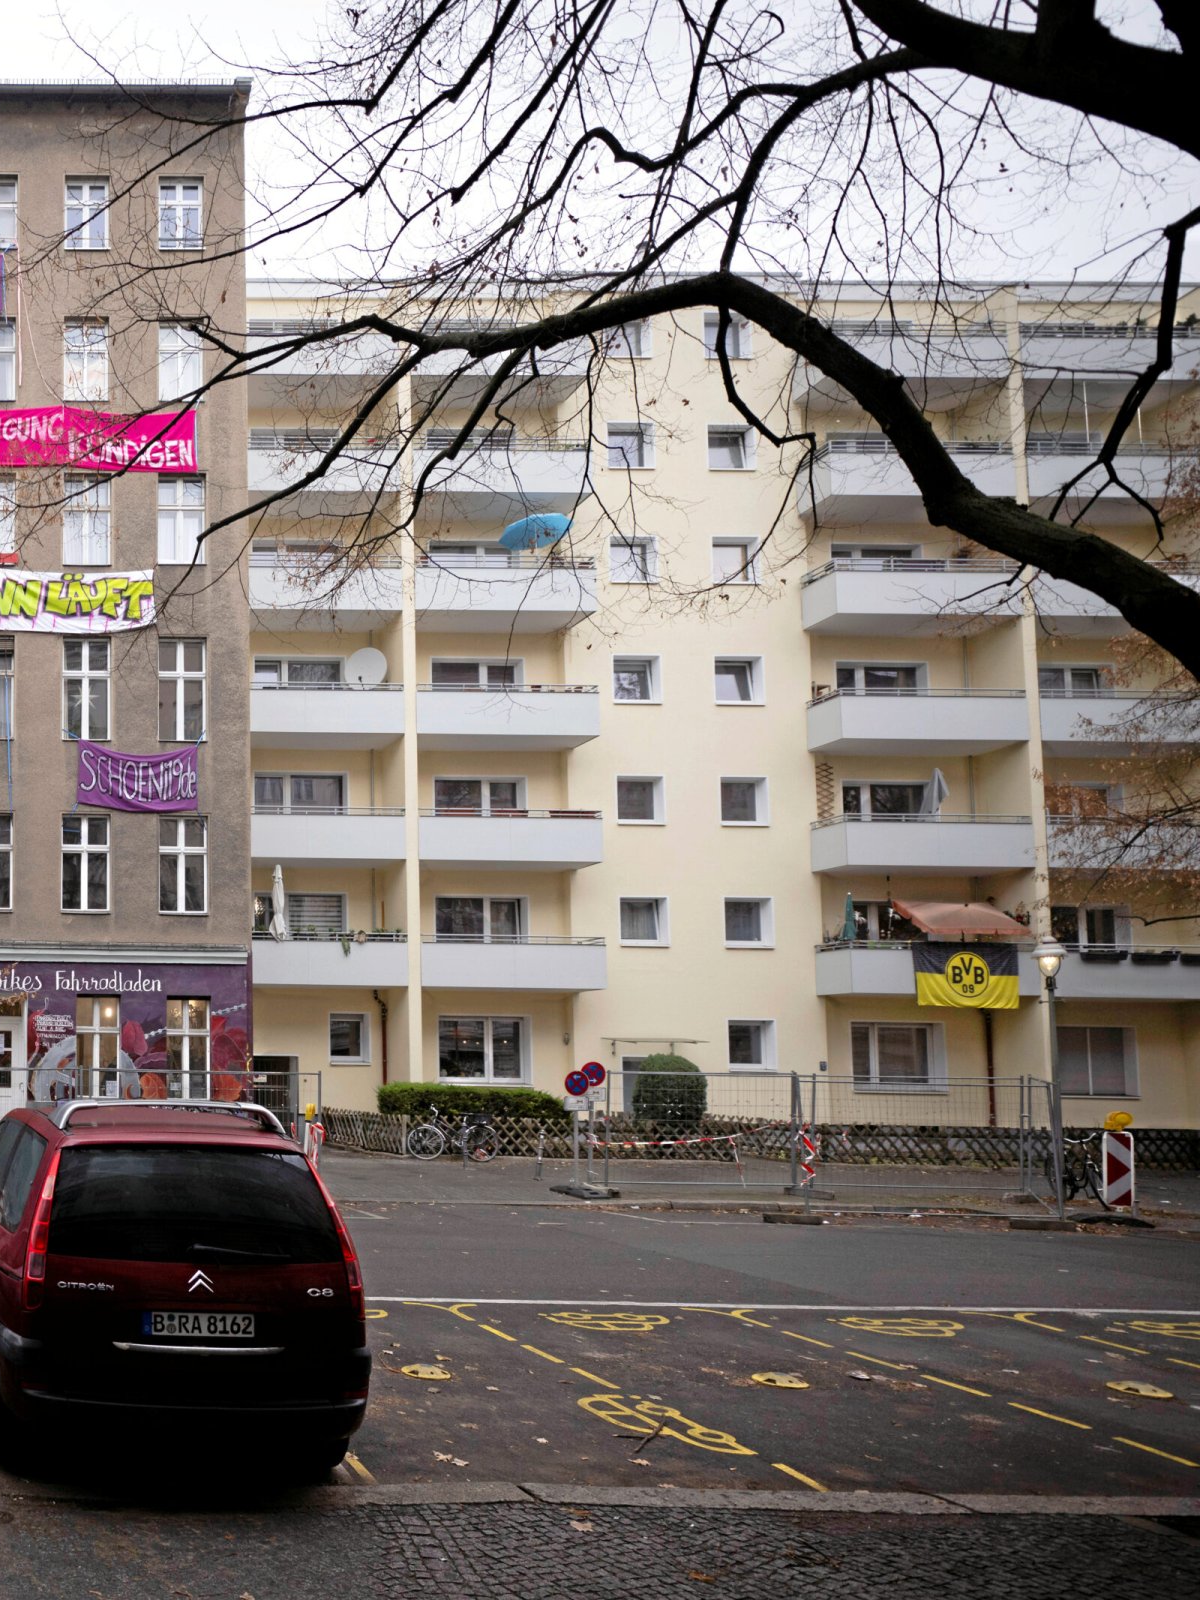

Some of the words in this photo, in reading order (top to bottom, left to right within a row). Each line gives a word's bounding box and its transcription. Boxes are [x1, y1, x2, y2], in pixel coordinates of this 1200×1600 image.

[44, 572, 154, 623] LÄUFT
[55, 969, 162, 992] Fahrradladen
[952, 957, 984, 984] BVB
[962, 984, 975, 994] 09
[57, 1280, 115, 1292] CITROËN
[306, 1287, 335, 1298] C8
[153, 1313, 166, 1333] B
[178, 1315, 202, 1334] RA
[206, 1315, 254, 1336] 8162
